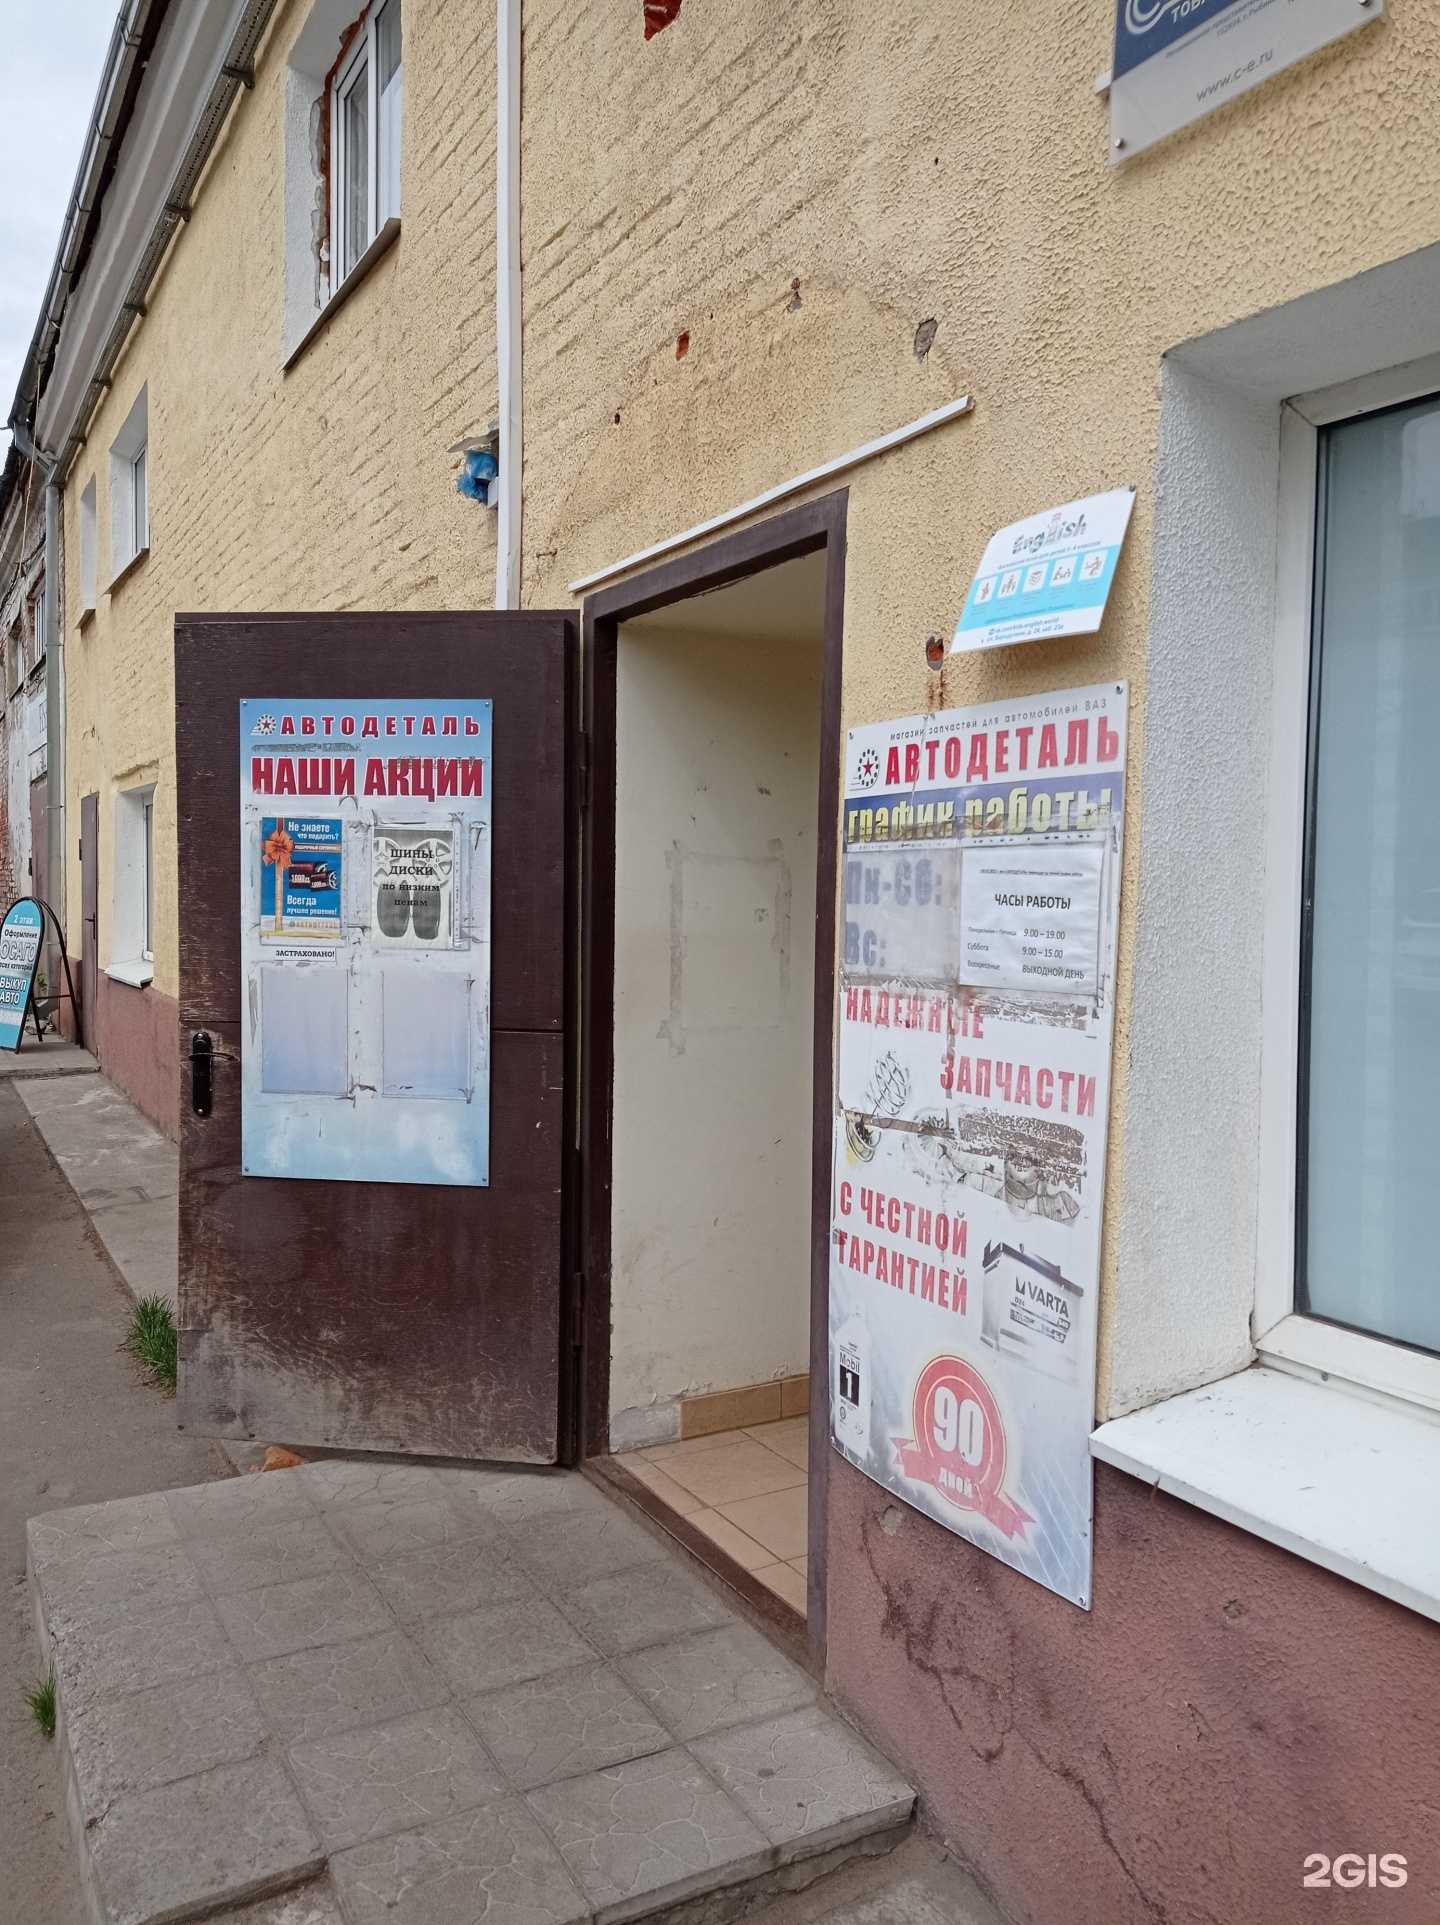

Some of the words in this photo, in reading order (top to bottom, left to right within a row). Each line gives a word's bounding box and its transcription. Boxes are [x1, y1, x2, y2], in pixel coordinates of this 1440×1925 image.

[1196, 49, 1274, 102] www.c-e.ru
[279, 715, 480, 738] АВТОДЕТАЛЬ
[890, 728, 925, 741] магазин
[929, 717, 978, 736] запчастей
[982, 715, 999, 730] для
[1004, 705, 1079, 725] автомобилей
[1084, 698, 1108, 713] ВАЗ
[885, 715, 1120, 786] АВТОДЕТАЛЬ
[251, 757, 356, 796] НАШИ
[363, 758, 484, 802] АКЦИИ
[848, 799, 956, 844] график
[965, 787, 1113, 838] работы
[288, 821, 299, 831] Не
[301, 824, 330, 833] знаете
[390, 848, 433, 859] ШИНЫ
[389, 865, 433, 876] ДИСКИ
[287, 895, 317, 906] Всегда
[994, 893, 1024, 907] ЧАСЫ
[1026, 895, 1071, 909] РАБОТЫ
[1023, 928, 1039, 938] 9.00
[0, 939, 36, 963] ОСАГО
[275, 949, 335, 958] ЗАСТРАХОВАНО!
[1022, 946, 1037, 956] 9.00
[1022, 964, 1064, 977] ВЫХОДНОЙ
[1064, 969, 1085, 979] ДЕНЬ
[0, 976, 27, 991] ВЫКУП
[0, 990, 20, 1004] АВТО
[940, 1055, 1096, 1117] ЗАПЧАСТИ
[839, 1181, 852, 1215] С
[860, 1186, 968, 1258] ЧЕСТНОЙ
[837, 1230, 967, 1316] ГАРАНТИЕЙ
[1028, 1281, 1069, 1318] VARTA
[839, 1352, 860, 1374] Mobil
[934, 1385, 984, 1467] 90
